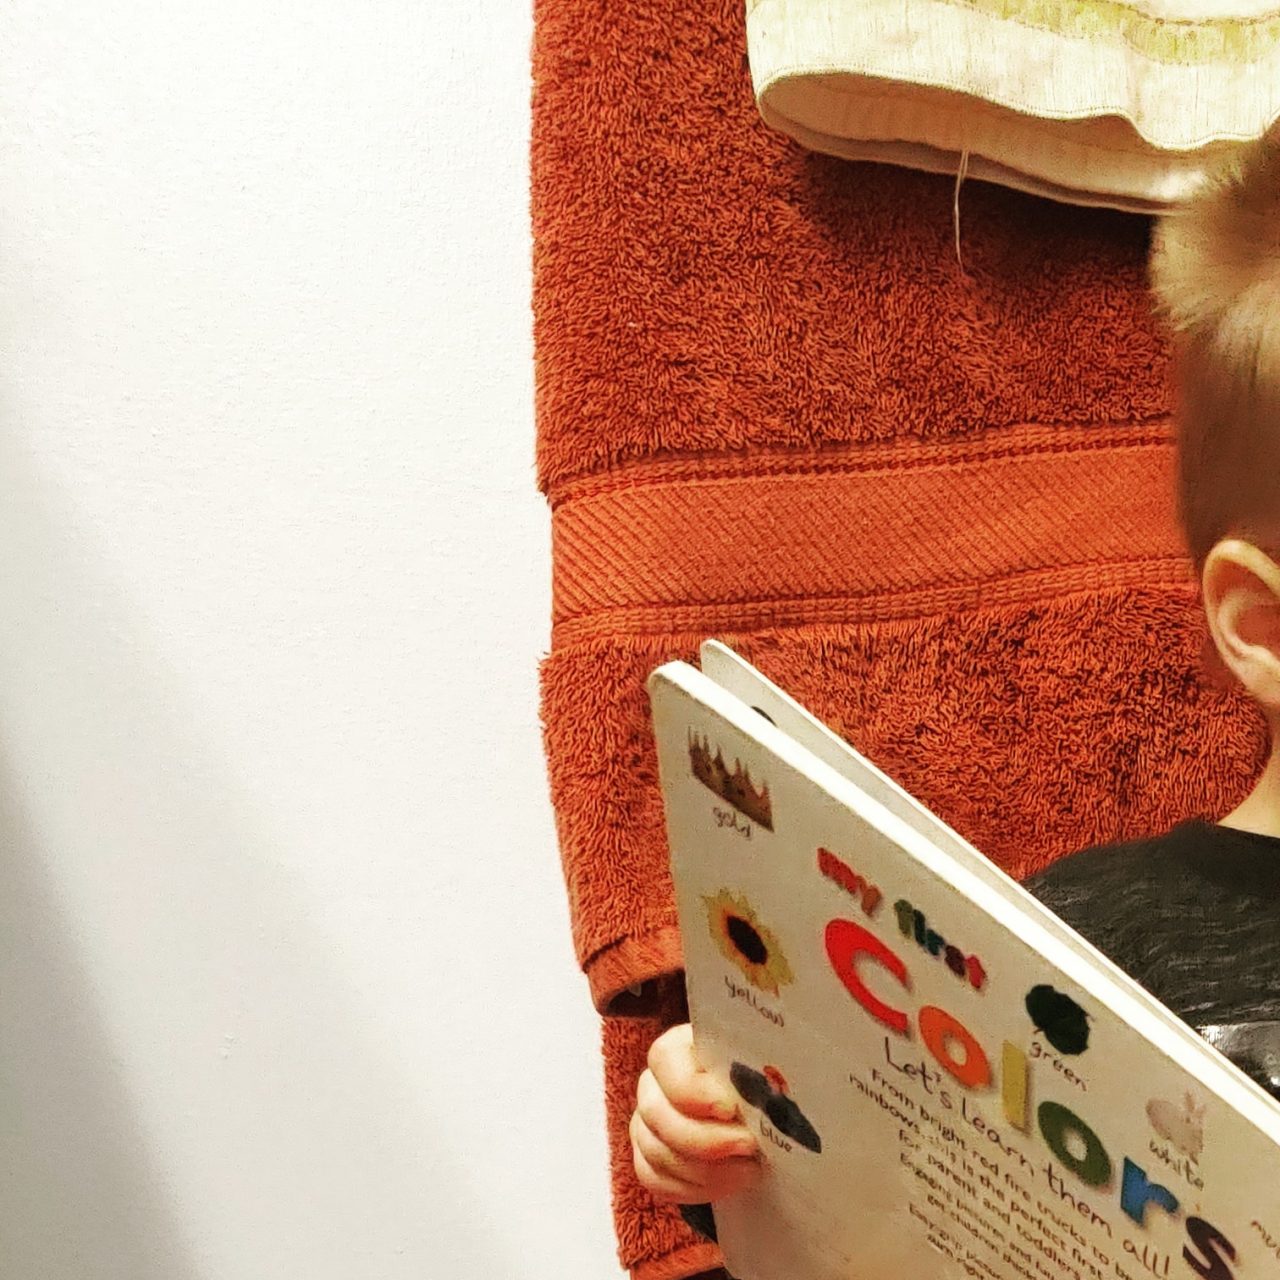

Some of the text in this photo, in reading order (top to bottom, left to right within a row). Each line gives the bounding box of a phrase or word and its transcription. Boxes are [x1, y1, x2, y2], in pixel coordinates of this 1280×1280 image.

[711, 805, 751, 840] gold
[724, 975, 785, 1028] yellow
[1030, 1041, 1088, 1092] green
[759, 1119, 794, 1154] blue
[884, 1036, 954, 1110] Let's
[961, 1097, 1036, 1178] learn
[1043, 1161, 1113, 1239] them
[872, 1067, 913, 1111] From
[920, 1104, 966, 1151] bright
[972, 1149, 998, 1177] red
[1004, 1171, 1030, 1203] fire
[1037, 1199, 1086, 1248] trucks
[1092, 1244, 1108, 1267] to
[898, 1126, 919, 1153] for
[982, 1197, 1010, 1226] and
[1149, 1138, 1204, 1192] white
[962, 1158, 973, 1177] is
[980, 1171, 1004, 1203] the
[1011, 1200, 1065, 1252] perfect
[950, 1211, 998, 1254] children
[1009, 1240, 1030, 1264] and
